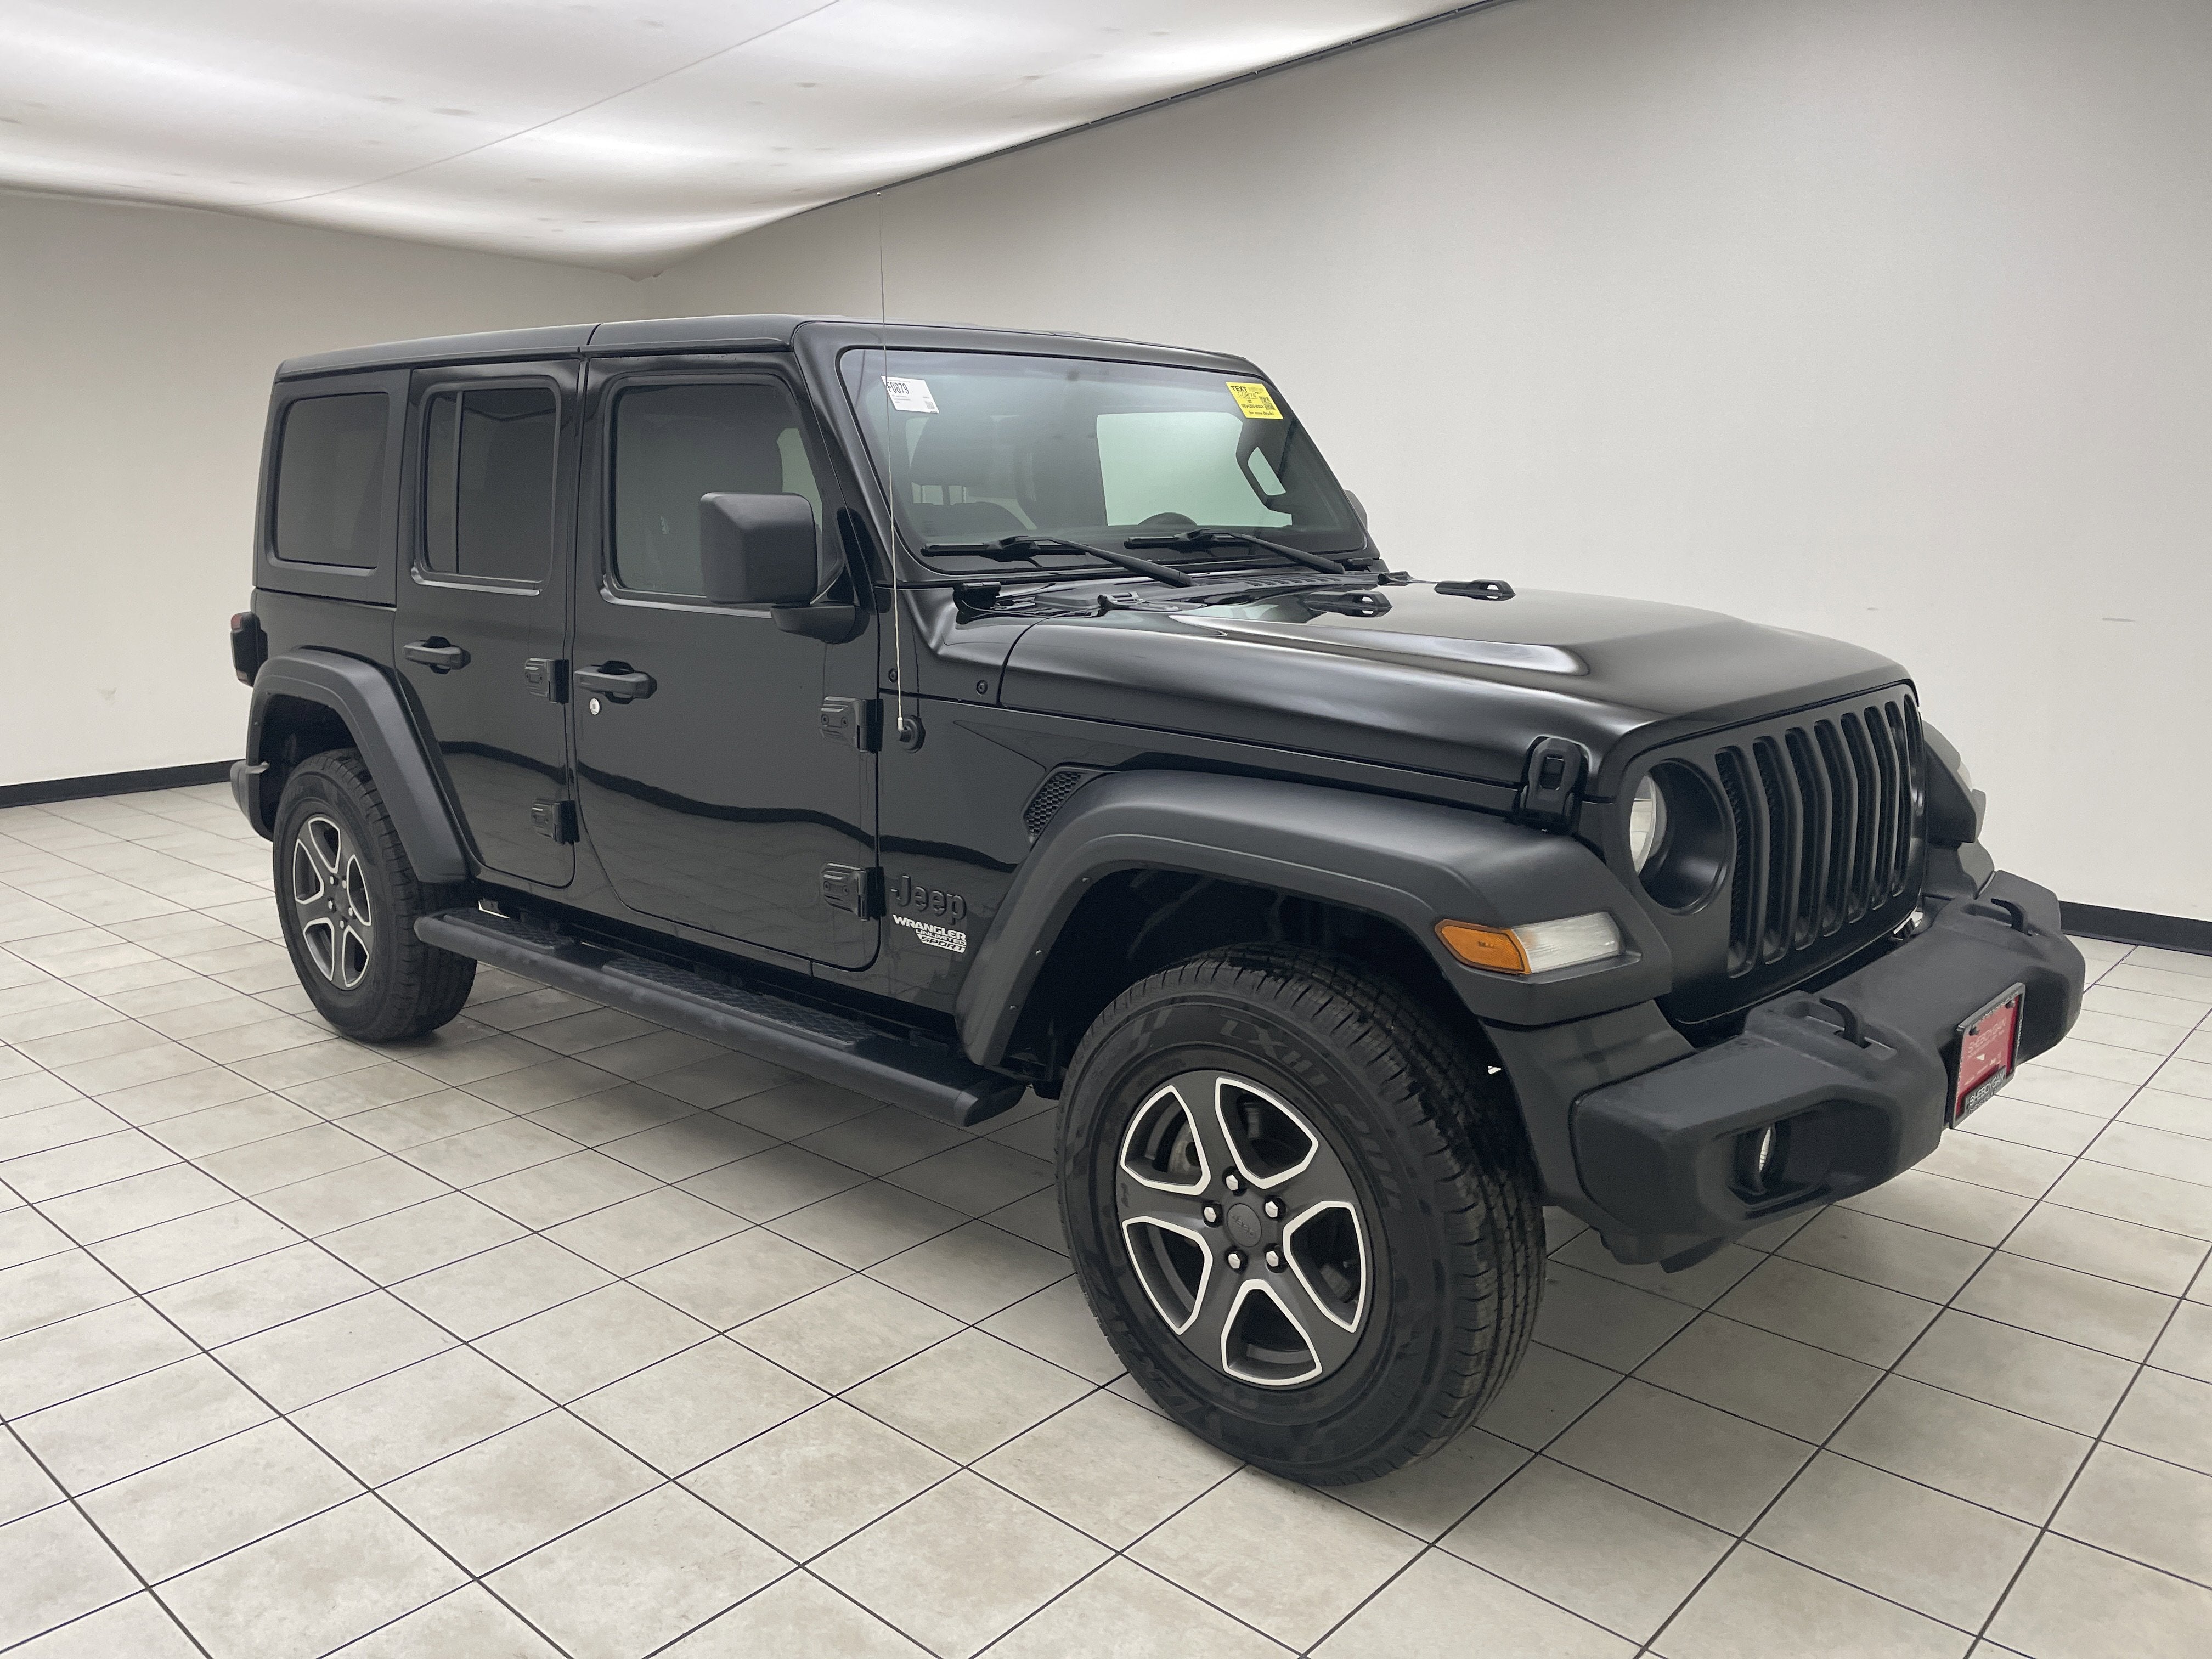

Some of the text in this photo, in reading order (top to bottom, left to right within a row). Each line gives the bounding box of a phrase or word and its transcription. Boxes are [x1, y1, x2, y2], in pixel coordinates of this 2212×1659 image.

[887, 382, 909, 394] F0879
[890, 875, 967, 926] Jeep
[893, 914, 966, 941] WRANGLER
[915, 928, 967, 946] UNLIMITED
[921, 935, 965, 951] SPORT
[1970, 1070, 2007, 1106] SHEBOYGAN
